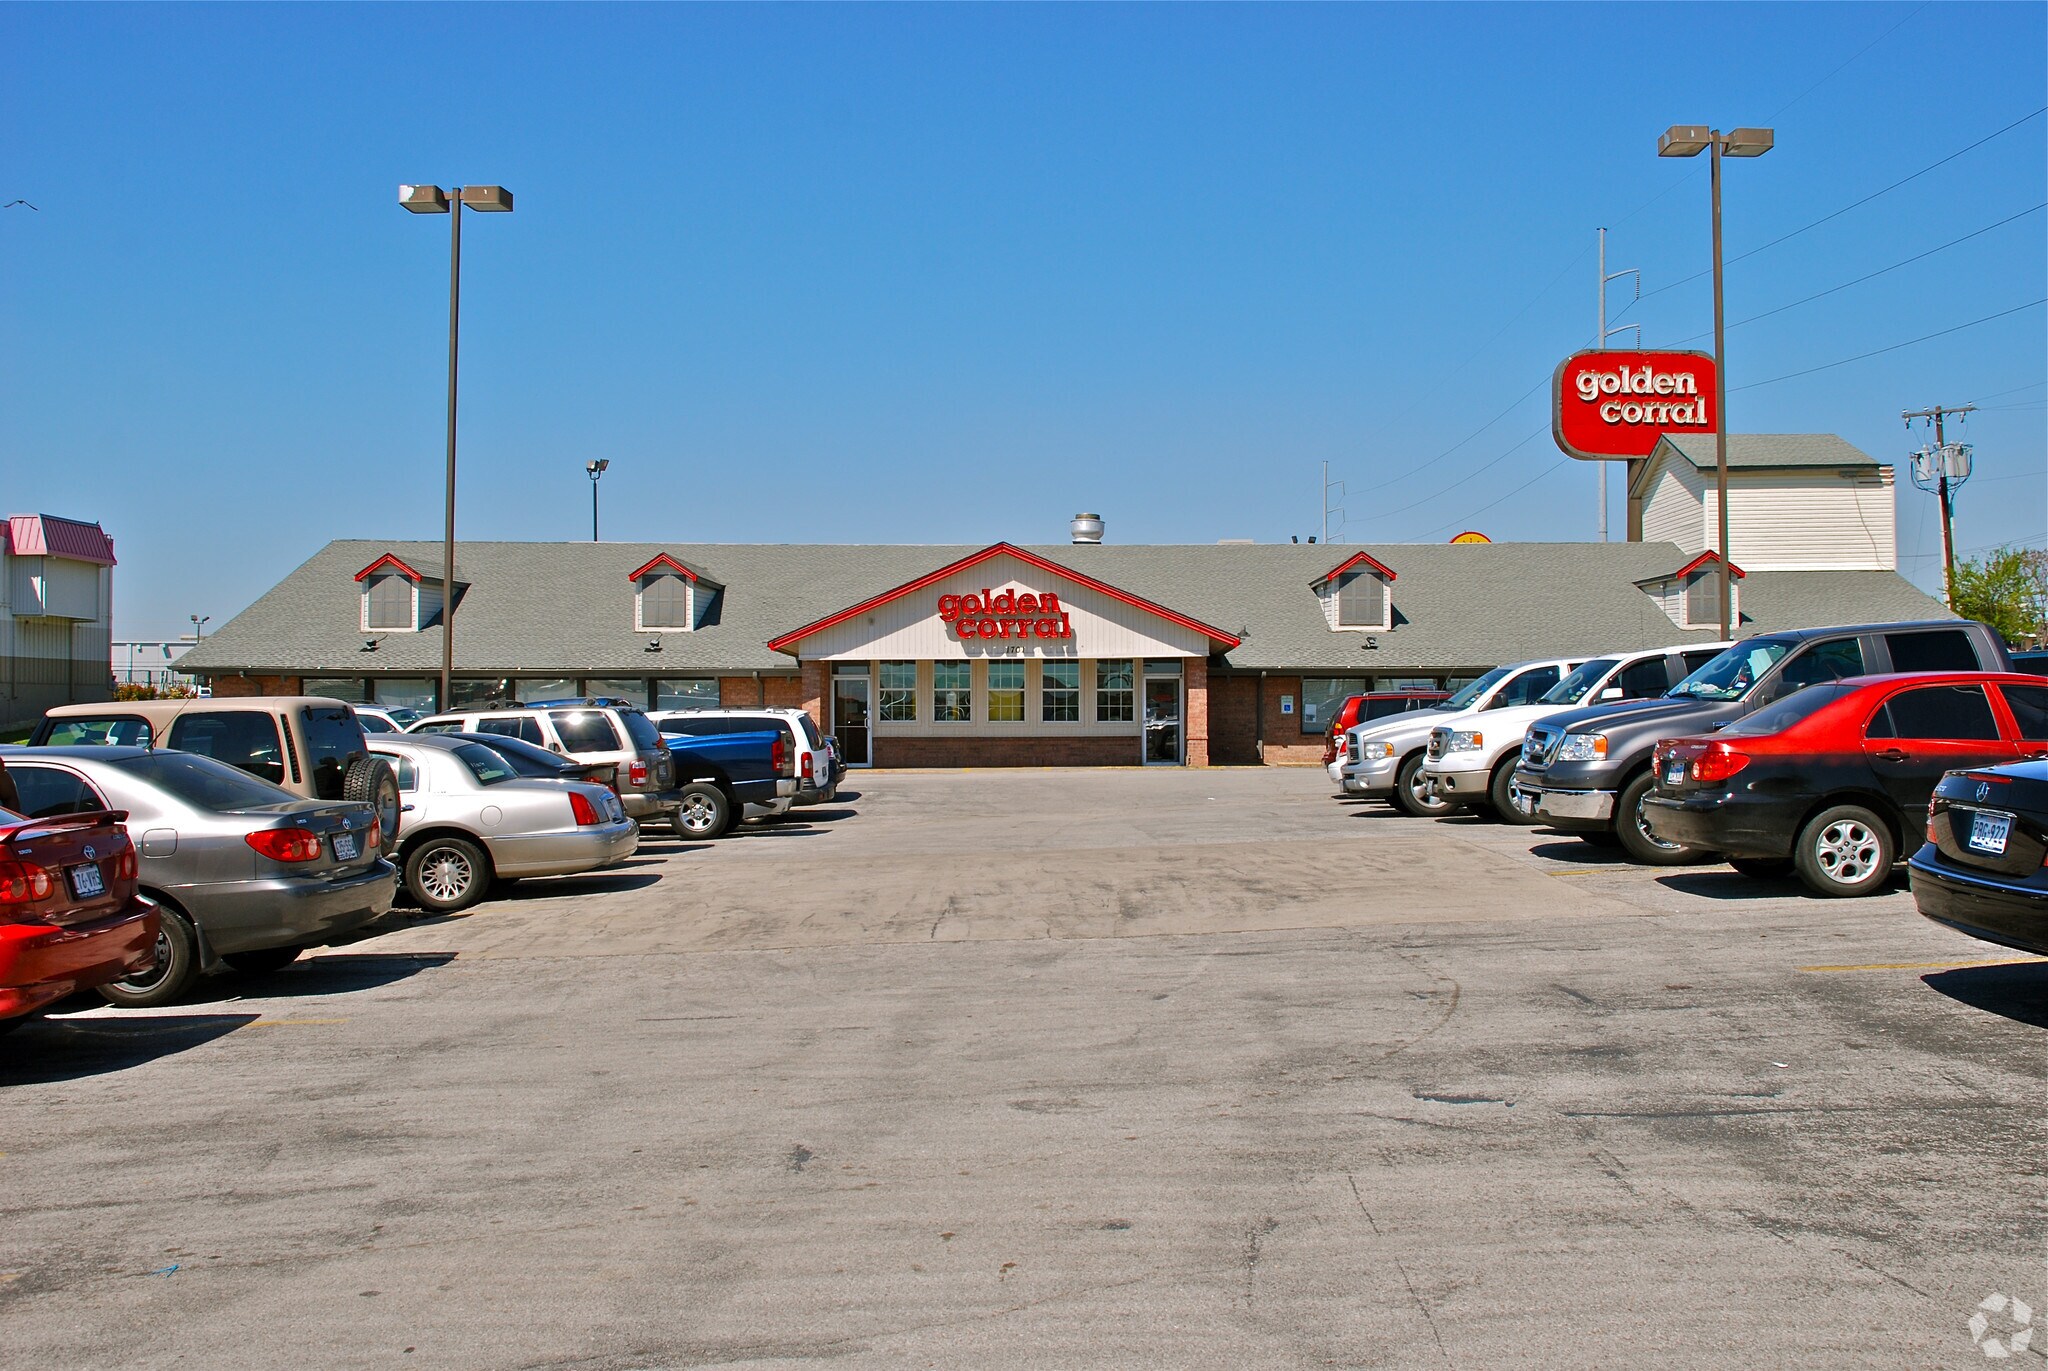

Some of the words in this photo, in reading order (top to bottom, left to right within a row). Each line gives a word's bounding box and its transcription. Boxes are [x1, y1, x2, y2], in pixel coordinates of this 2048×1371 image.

[1576, 365, 1698, 401] golden
[1600, 396, 1708, 424] corral
[938, 588, 1061, 622] golden
[955, 612, 1072, 639] corral
[1006, 646, 1026, 654] 1701
